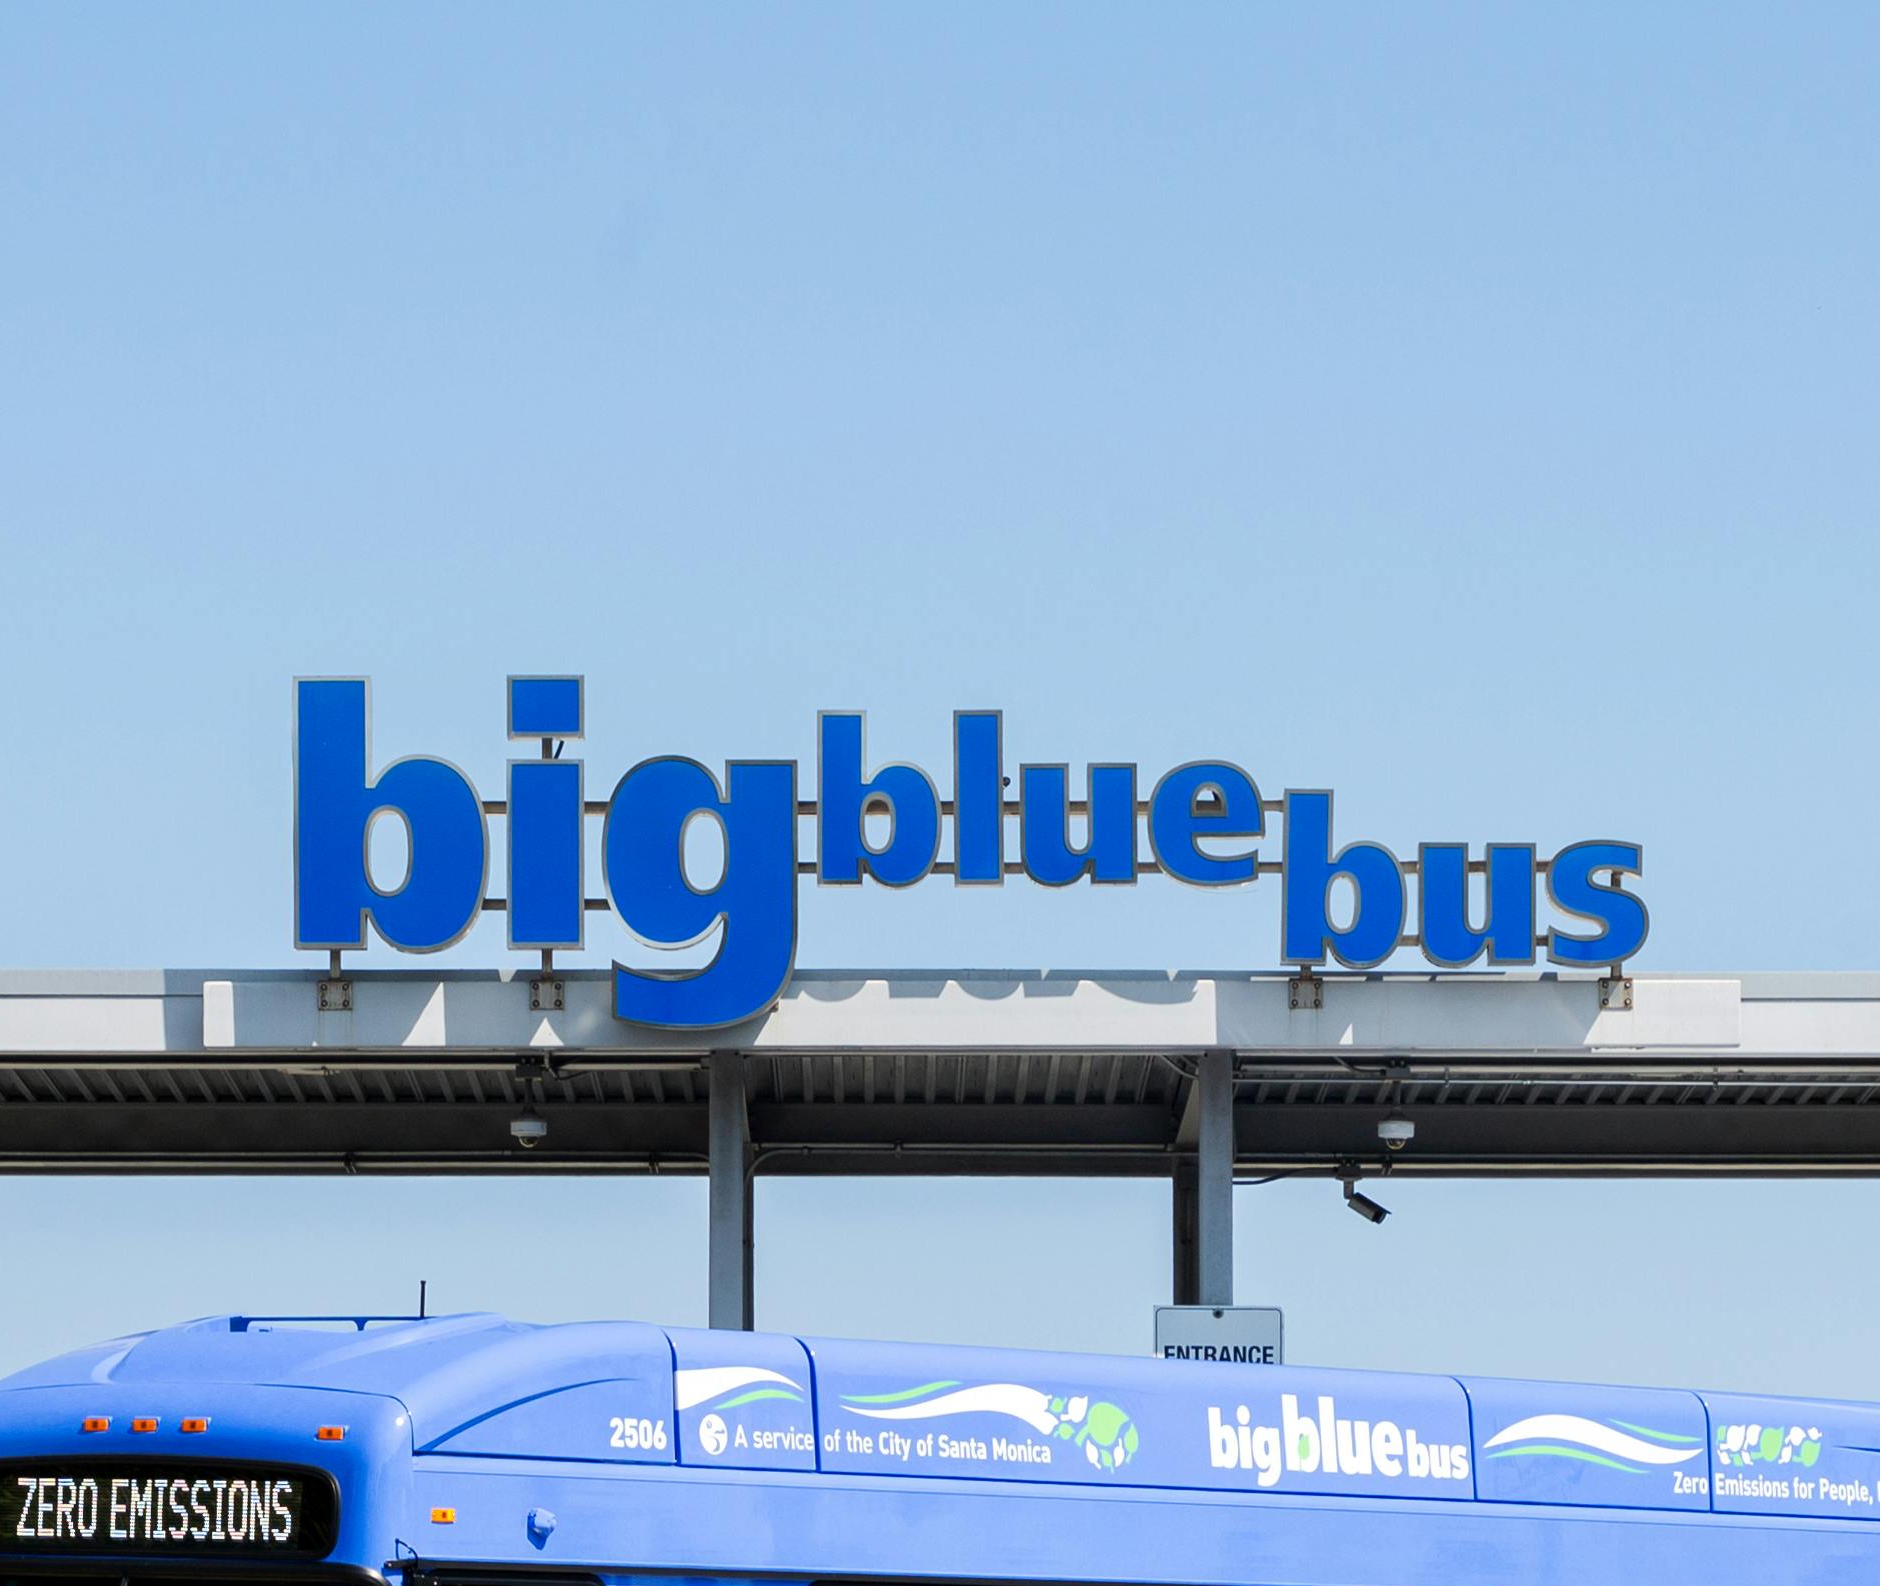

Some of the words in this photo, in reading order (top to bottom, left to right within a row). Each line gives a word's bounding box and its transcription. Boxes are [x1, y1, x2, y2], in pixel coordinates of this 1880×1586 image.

[293, 676, 797, 1030] big
[817, 710, 1266, 887] blue
[1281, 788, 1650, 969] bus
[1163, 1345, 1274, 1365] ENTRANCE
[610, 1417, 667, 1450] 2506
[734, 1425, 748, 1448] A
[752, 1425, 814, 1451] service
[824, 1429, 842, 1452] of
[845, 1430, 873, 1454] the
[878, 1431, 911, 1462] City
[916, 1433, 934, 1457] of
[938, 1434, 987, 1460] Santa
[992, 1438, 1051, 1463] Monica
[1207, 1404, 1282, 1487] big
[1281, 1393, 1404, 1477] blue
[1405, 1429, 1469, 1480] bus
[1673, 1471, 1709, 1494] Zero
[1715, 1472, 1790, 1498] Emissions
[1793, 1477, 1815, 1499] for
[1819, 1478, 1873, 1506] People,
[16, 1477, 97, 1538] ZERO
[109, 1478, 293, 1541] EMISSIONS
